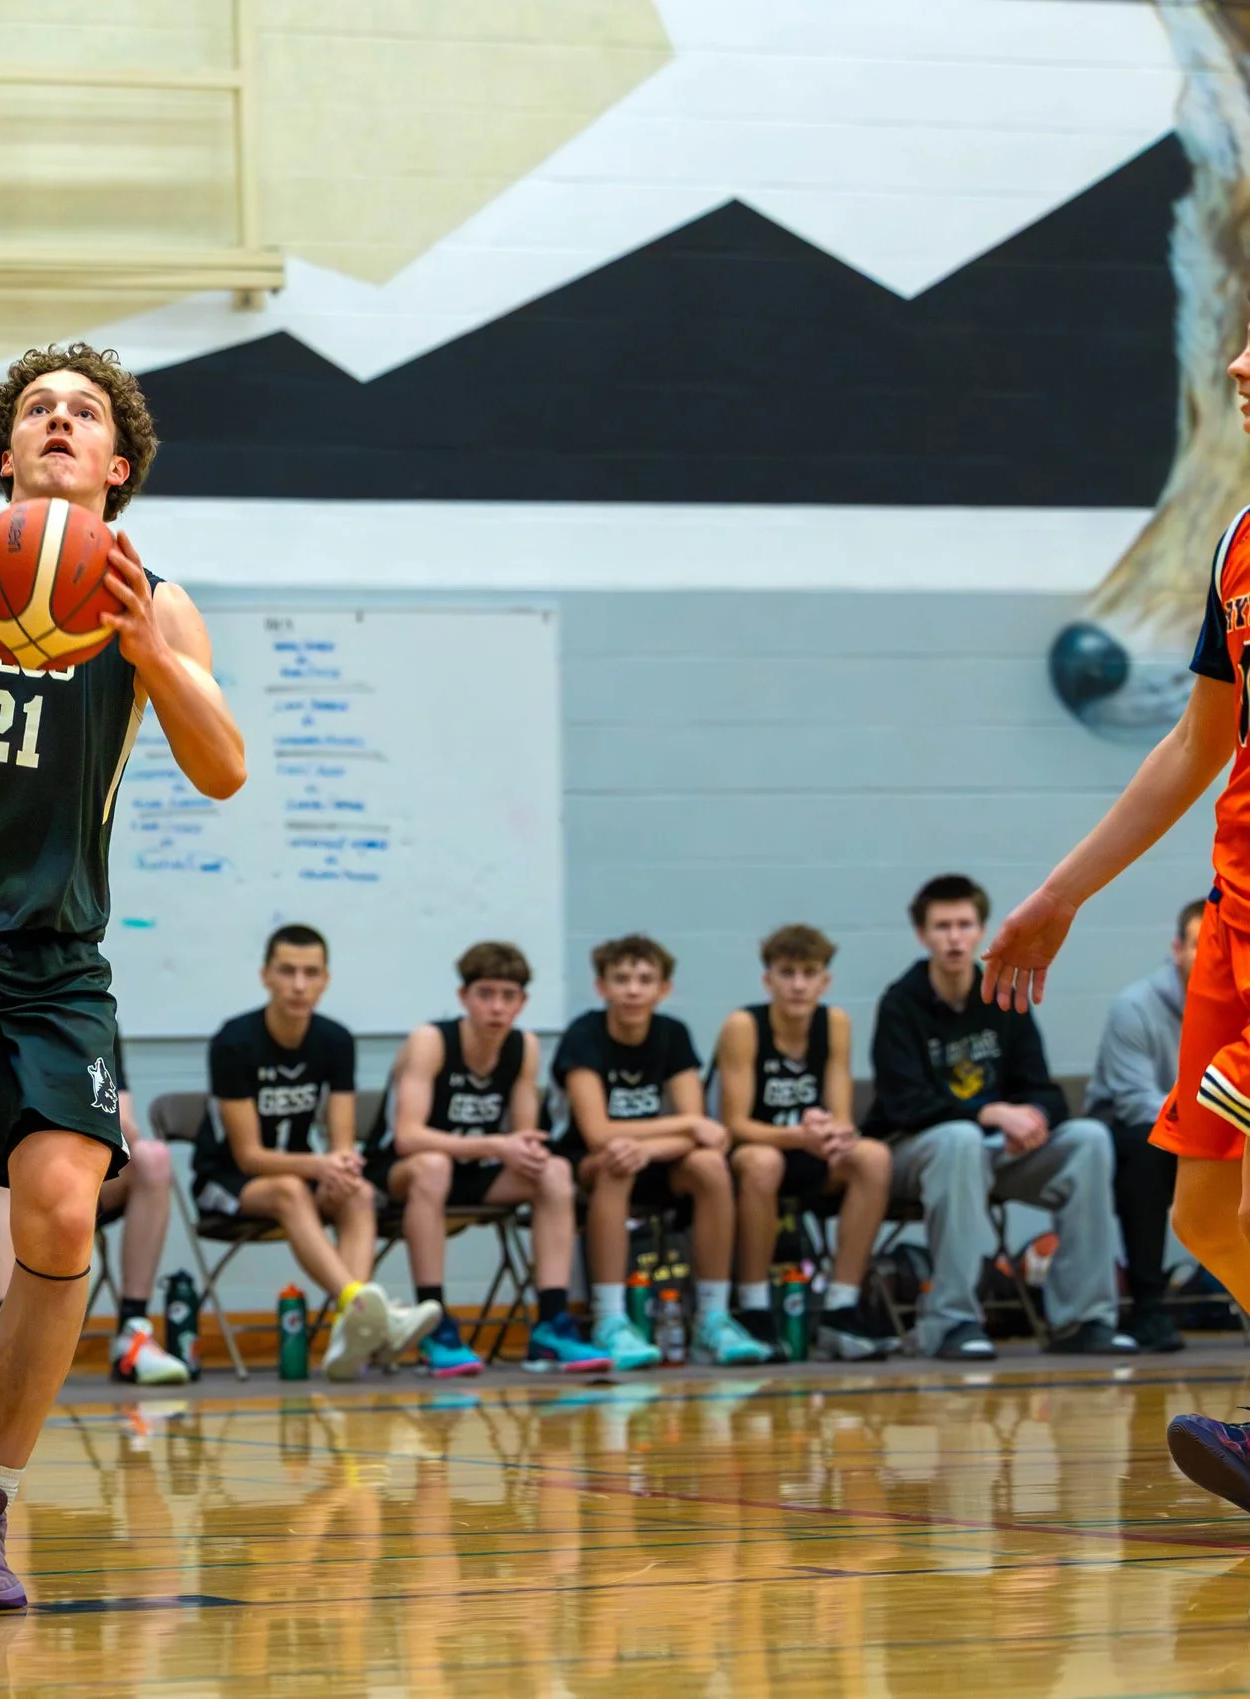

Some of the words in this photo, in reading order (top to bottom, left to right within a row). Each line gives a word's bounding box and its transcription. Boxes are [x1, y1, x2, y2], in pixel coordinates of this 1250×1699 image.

[258, 1084, 317, 1115] GESS
[448, 1093, 503, 1123] GESS
[609, 1084, 660, 1117] GESS
